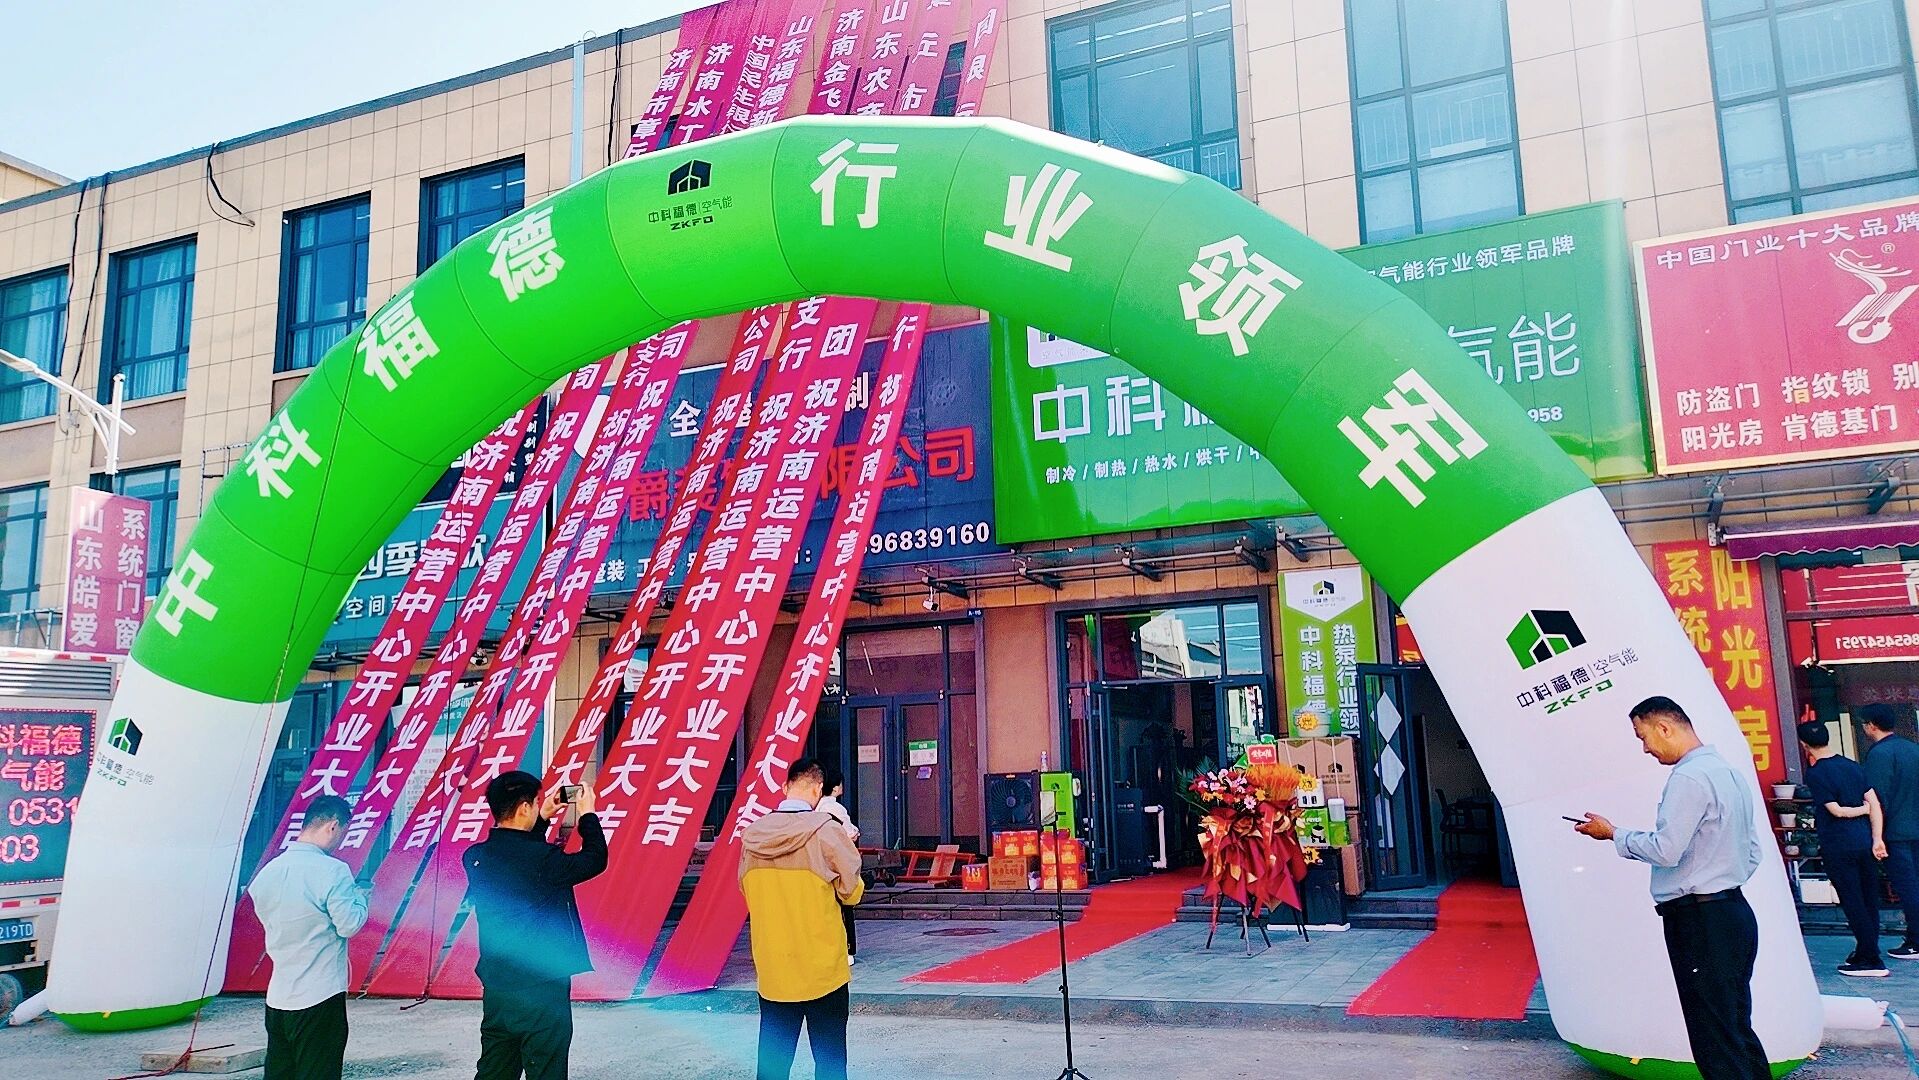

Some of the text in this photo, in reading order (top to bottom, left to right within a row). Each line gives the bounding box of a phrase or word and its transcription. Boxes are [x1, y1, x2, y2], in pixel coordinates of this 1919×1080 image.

[818, 8, 864, 115] 济南金飞
[1366, 234, 1576, 284] 气能行业领军品牌
[1527, 406, 1563, 422] 958
[1676, 382, 1760, 416] 防盗门
[1780, 367, 1871, 405] 指纹锁
[1681, 404, 1898, 452] 阳光房 肯德基门
[864, 522, 990, 554] 96839160
[115, 507, 146, 650] 系统门窗
[1665, 549, 1714, 684] 系统
[1333, 624, 1360, 738] 热泵行业领
[1516, 647, 1638, 708] 中科福德 空气能
[0, 834, 39, 863] 03
